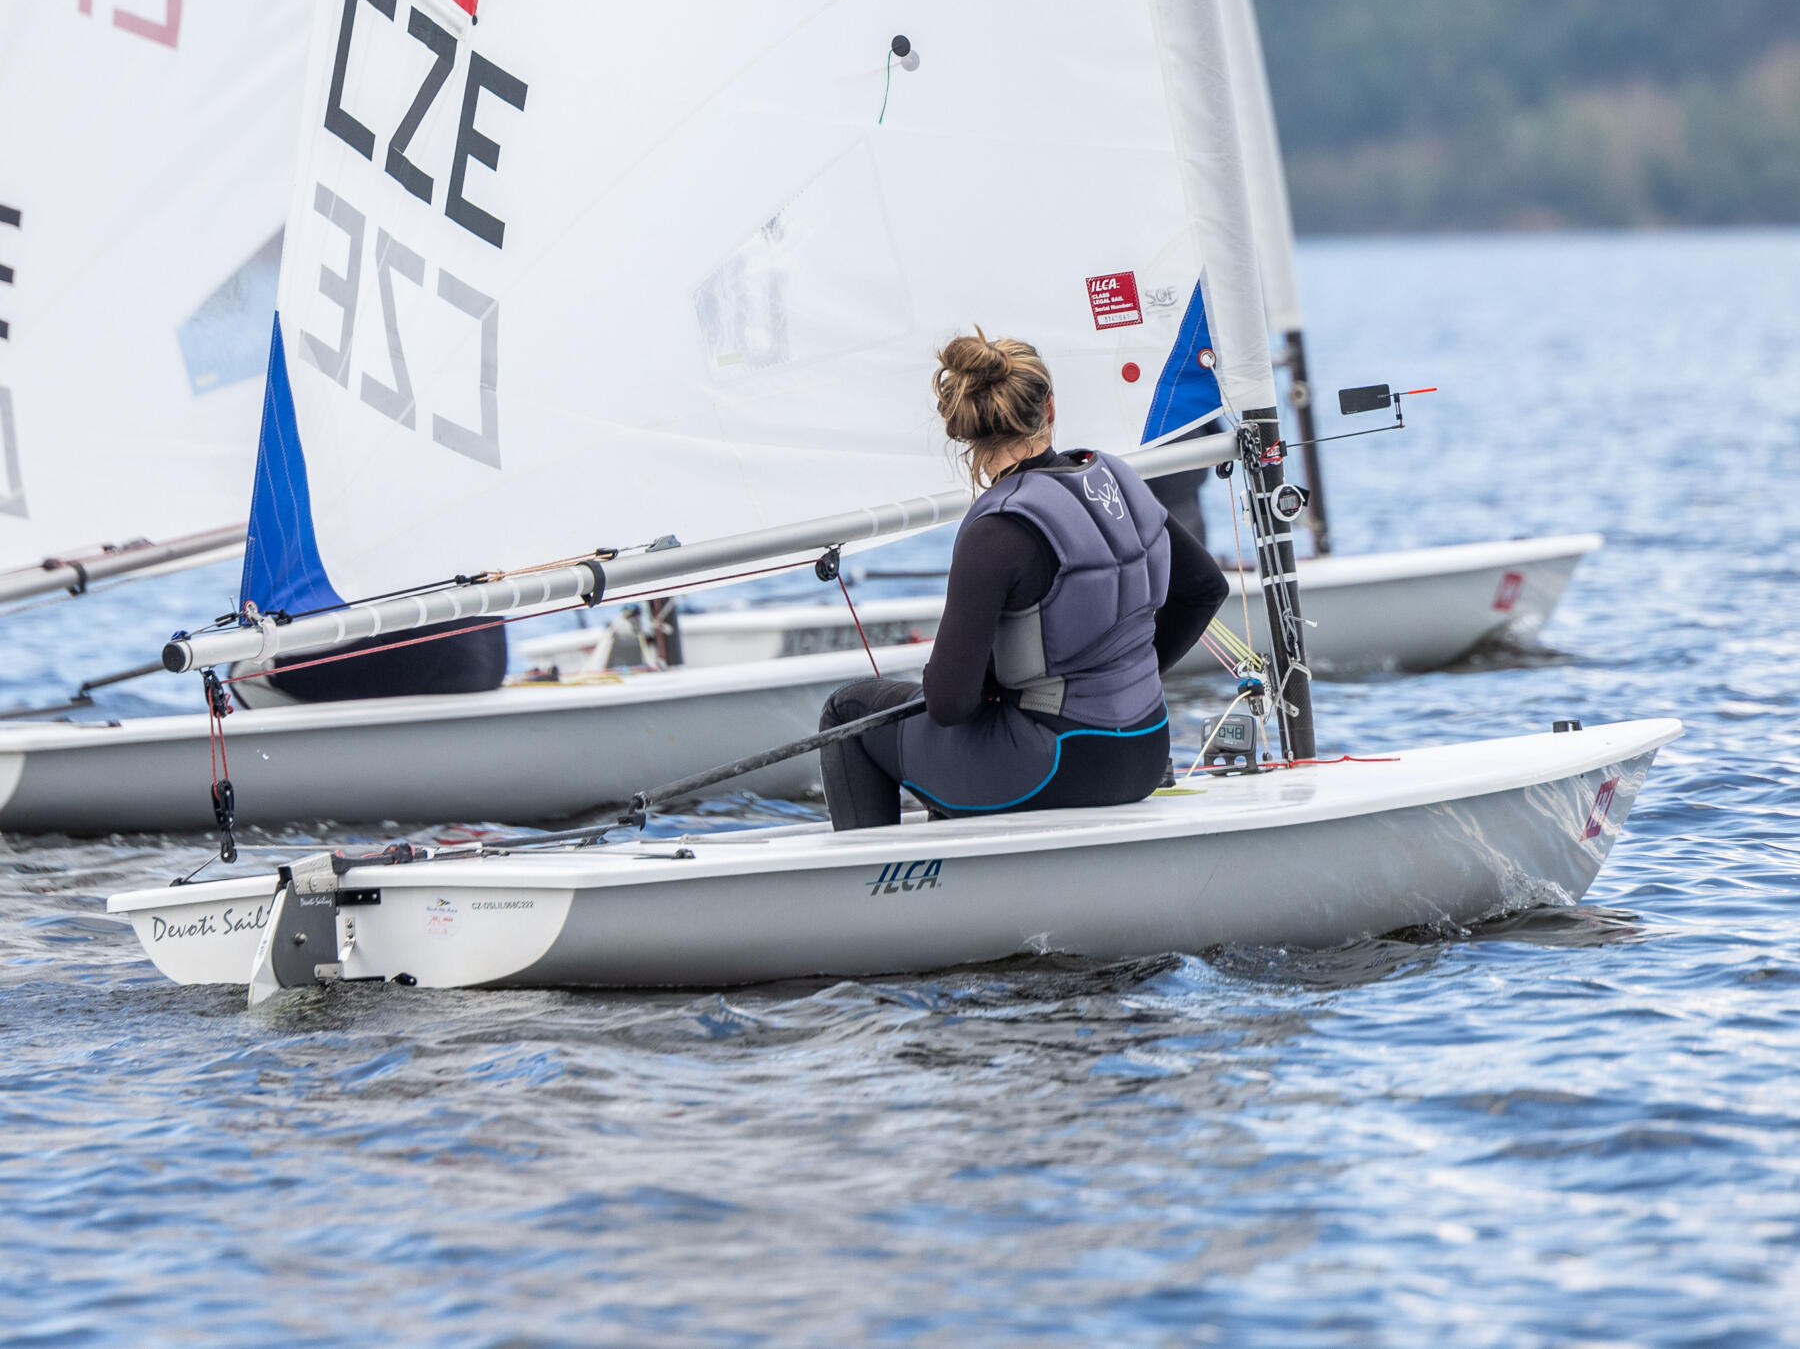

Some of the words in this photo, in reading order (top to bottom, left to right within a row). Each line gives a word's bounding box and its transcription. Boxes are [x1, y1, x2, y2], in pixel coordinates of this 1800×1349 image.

[1091, 278, 1117, 292] ILCA
[869, 858, 943, 897] ILCA
[152, 916, 216, 942] Devoti
[223, 906, 271, 935] Sail
